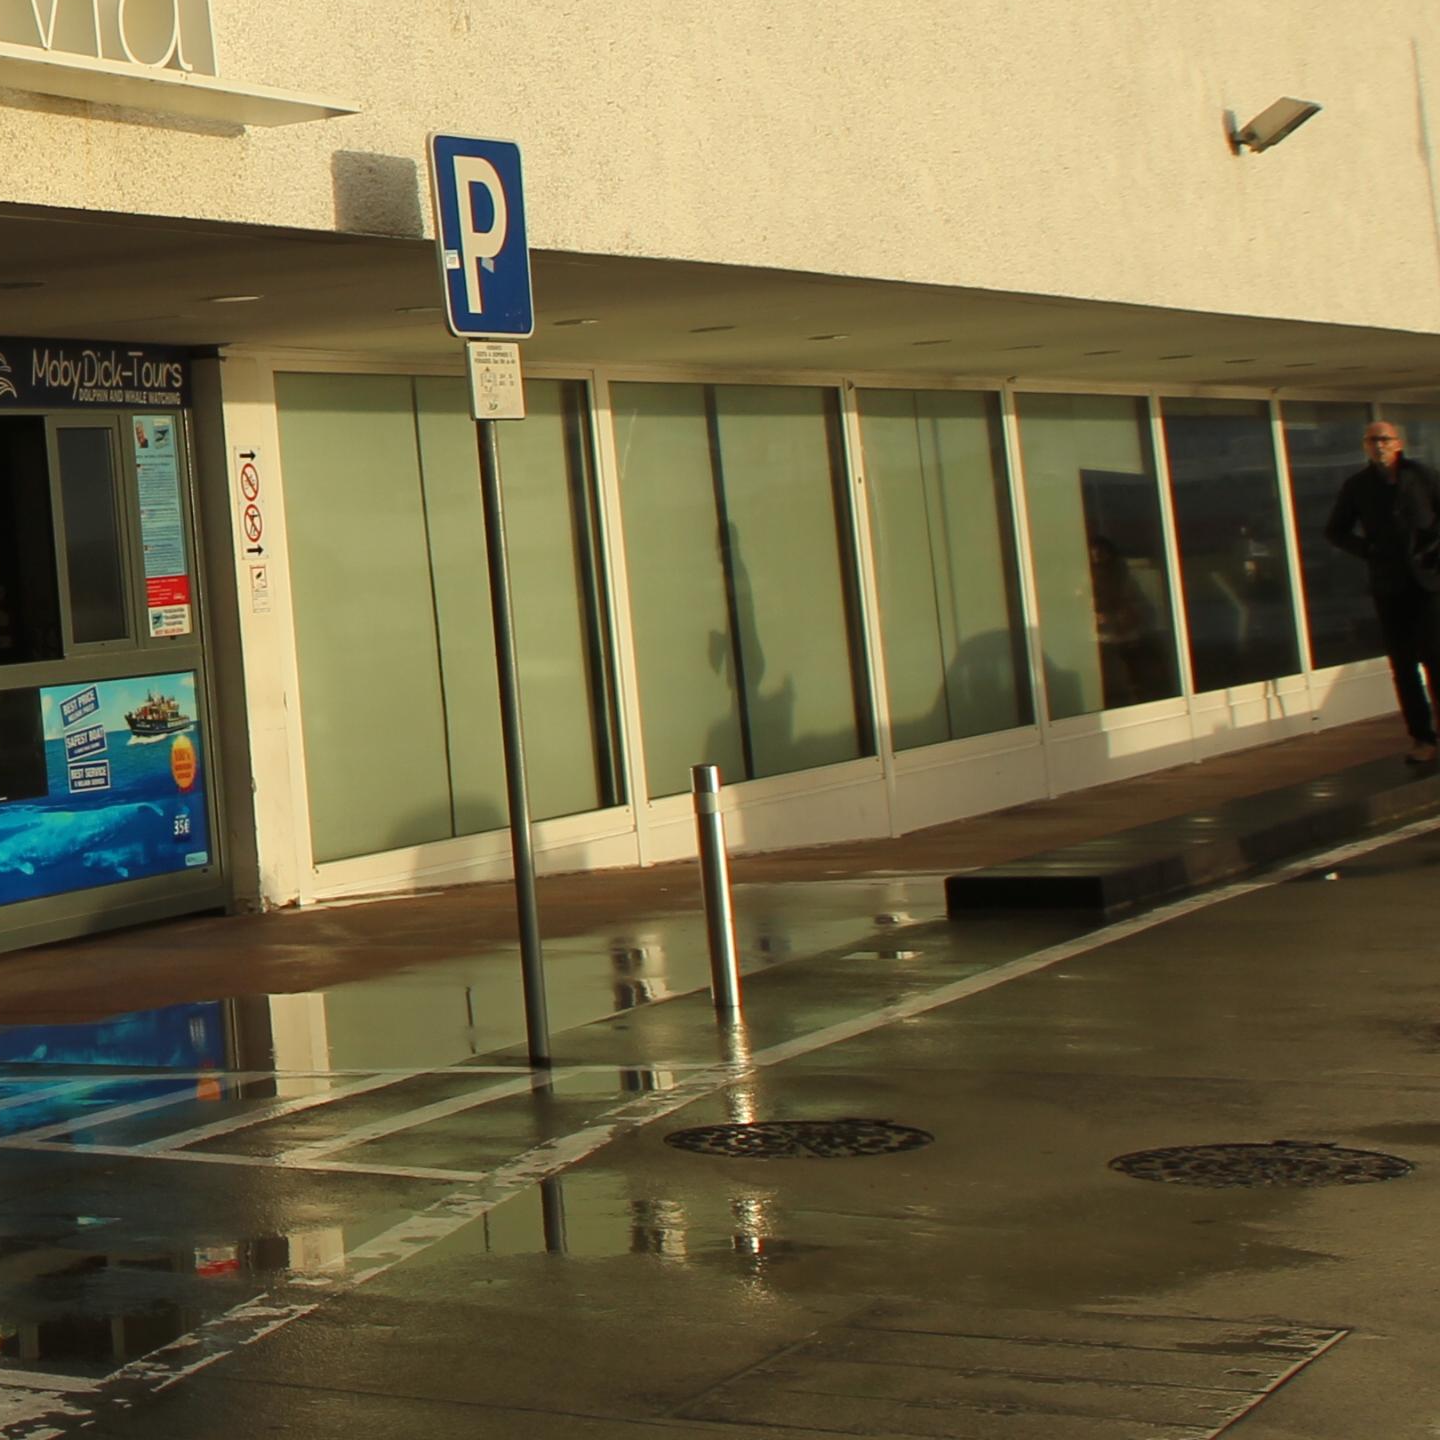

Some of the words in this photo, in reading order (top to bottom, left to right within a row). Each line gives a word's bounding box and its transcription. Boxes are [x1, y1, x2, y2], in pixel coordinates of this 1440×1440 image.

[453, 156, 507, 315] P
[31, 348, 83, 400] Moby
[81, 349, 183, 388] Dick-Tours
[78, 388, 109, 402] DOLPHIN
[109, 389, 124, 403] AND
[124, 390, 147, 404] WHALE
[147, 391, 181, 405] WATCHING
[78, 689, 96, 707] PRICE
[65, 733, 88, 749] SAFEST
[84, 766, 107, 778] SERVICE
[173, 818, 191, 836] 35€
